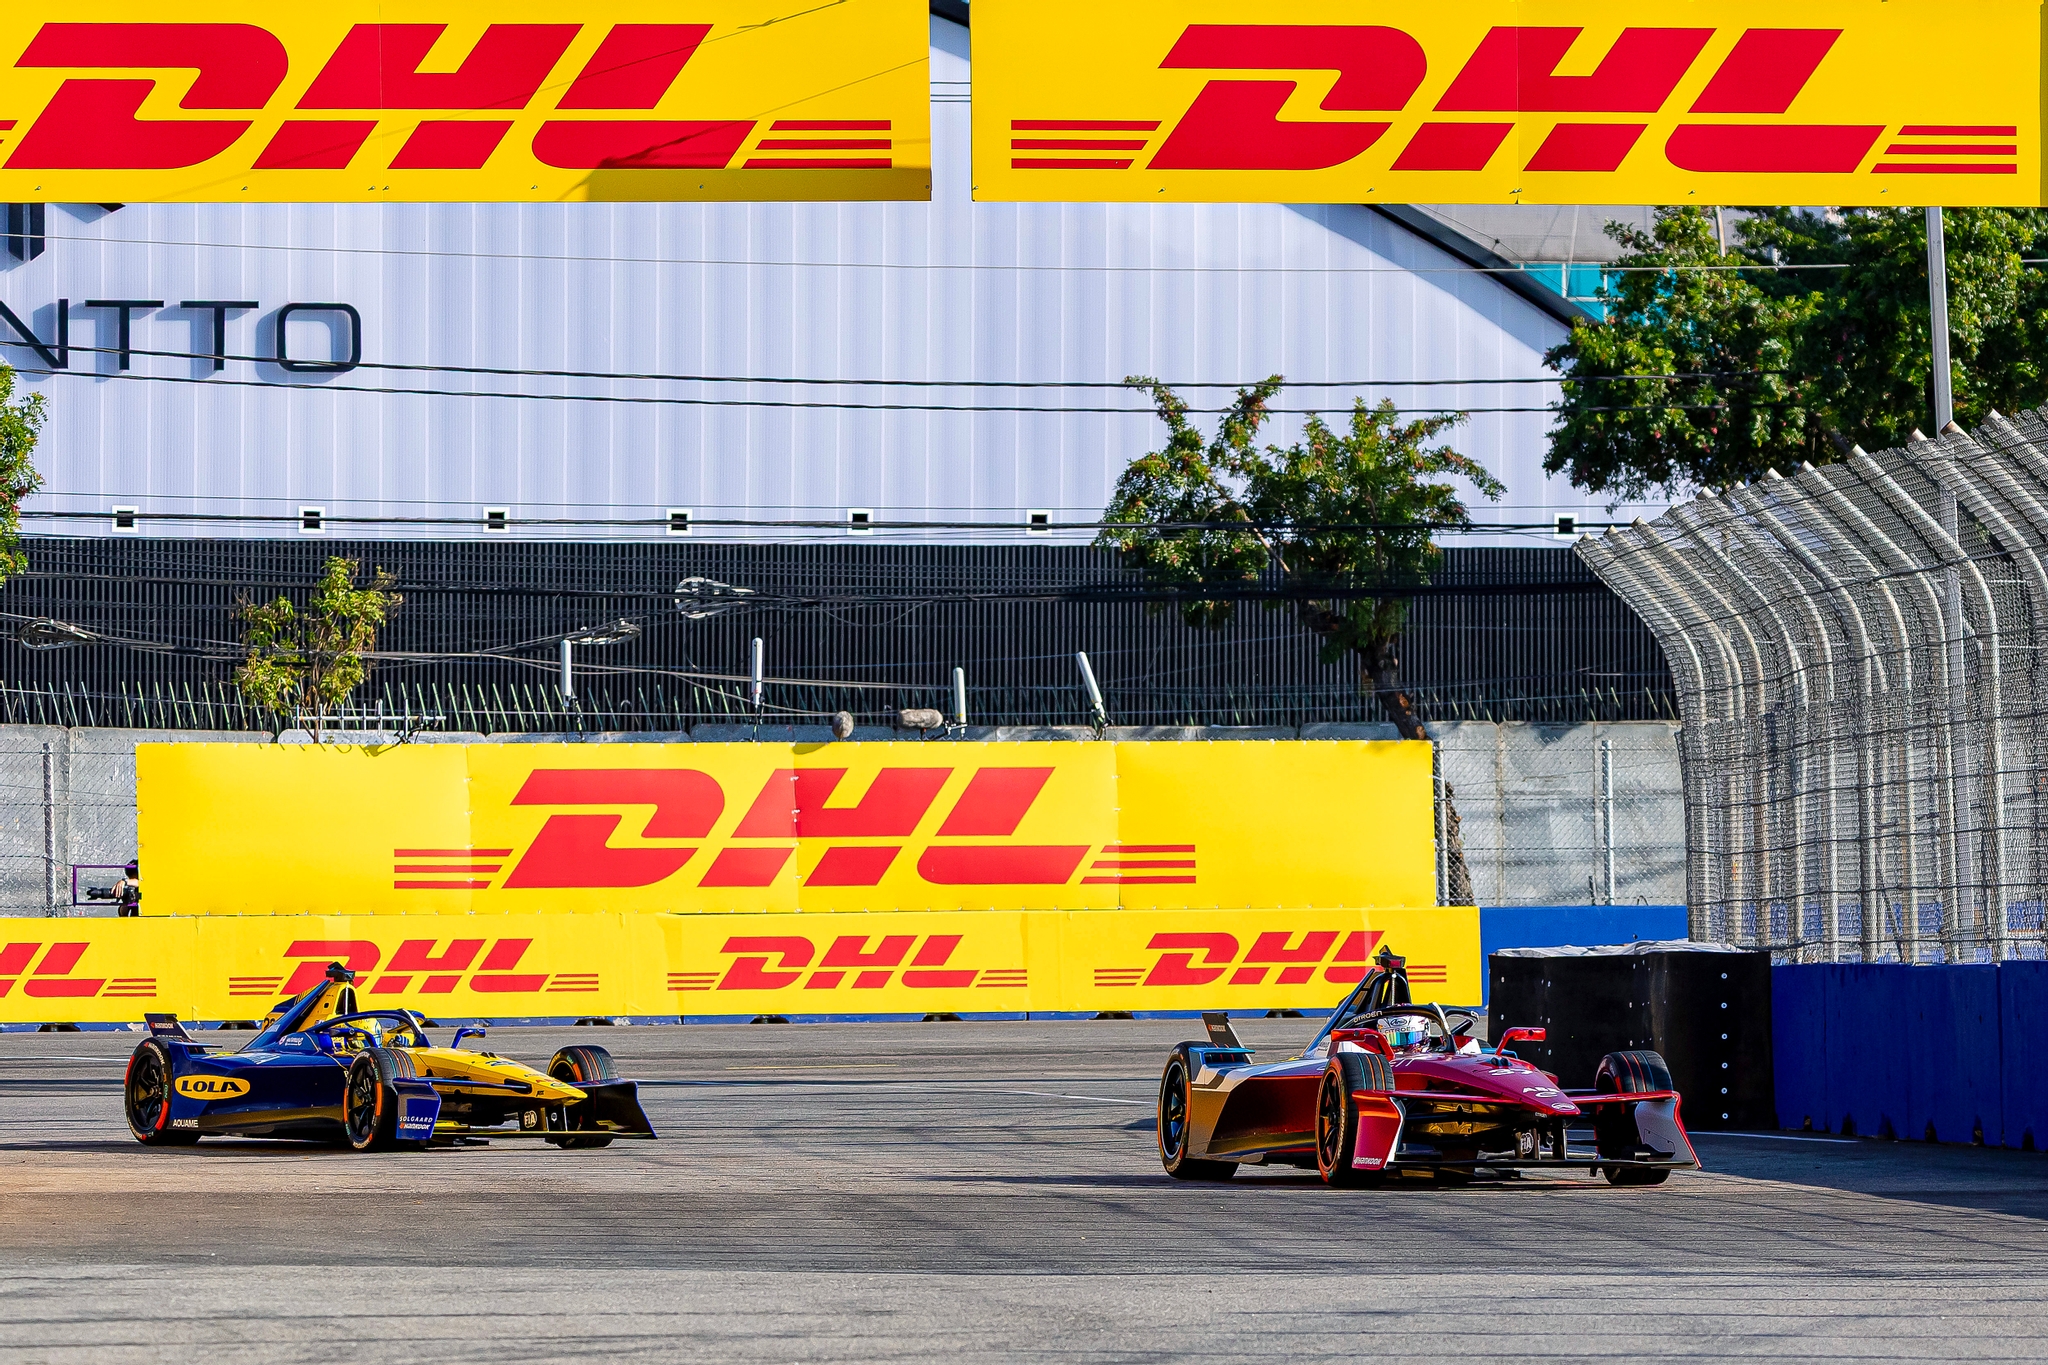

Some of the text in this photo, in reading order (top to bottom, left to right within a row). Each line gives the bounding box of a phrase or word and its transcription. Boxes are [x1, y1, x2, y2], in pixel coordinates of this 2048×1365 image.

[4, 23, 757, 169] DHL
[1147, 25, 1885, 172] DHL
[504, 768, 1088, 888] DHL
[282, 940, 547, 995] DHL
[719, 936, 977, 989] DHL
[1145, 932, 1382, 985] DHL
[181, 1080, 243, 1092] LOLA
